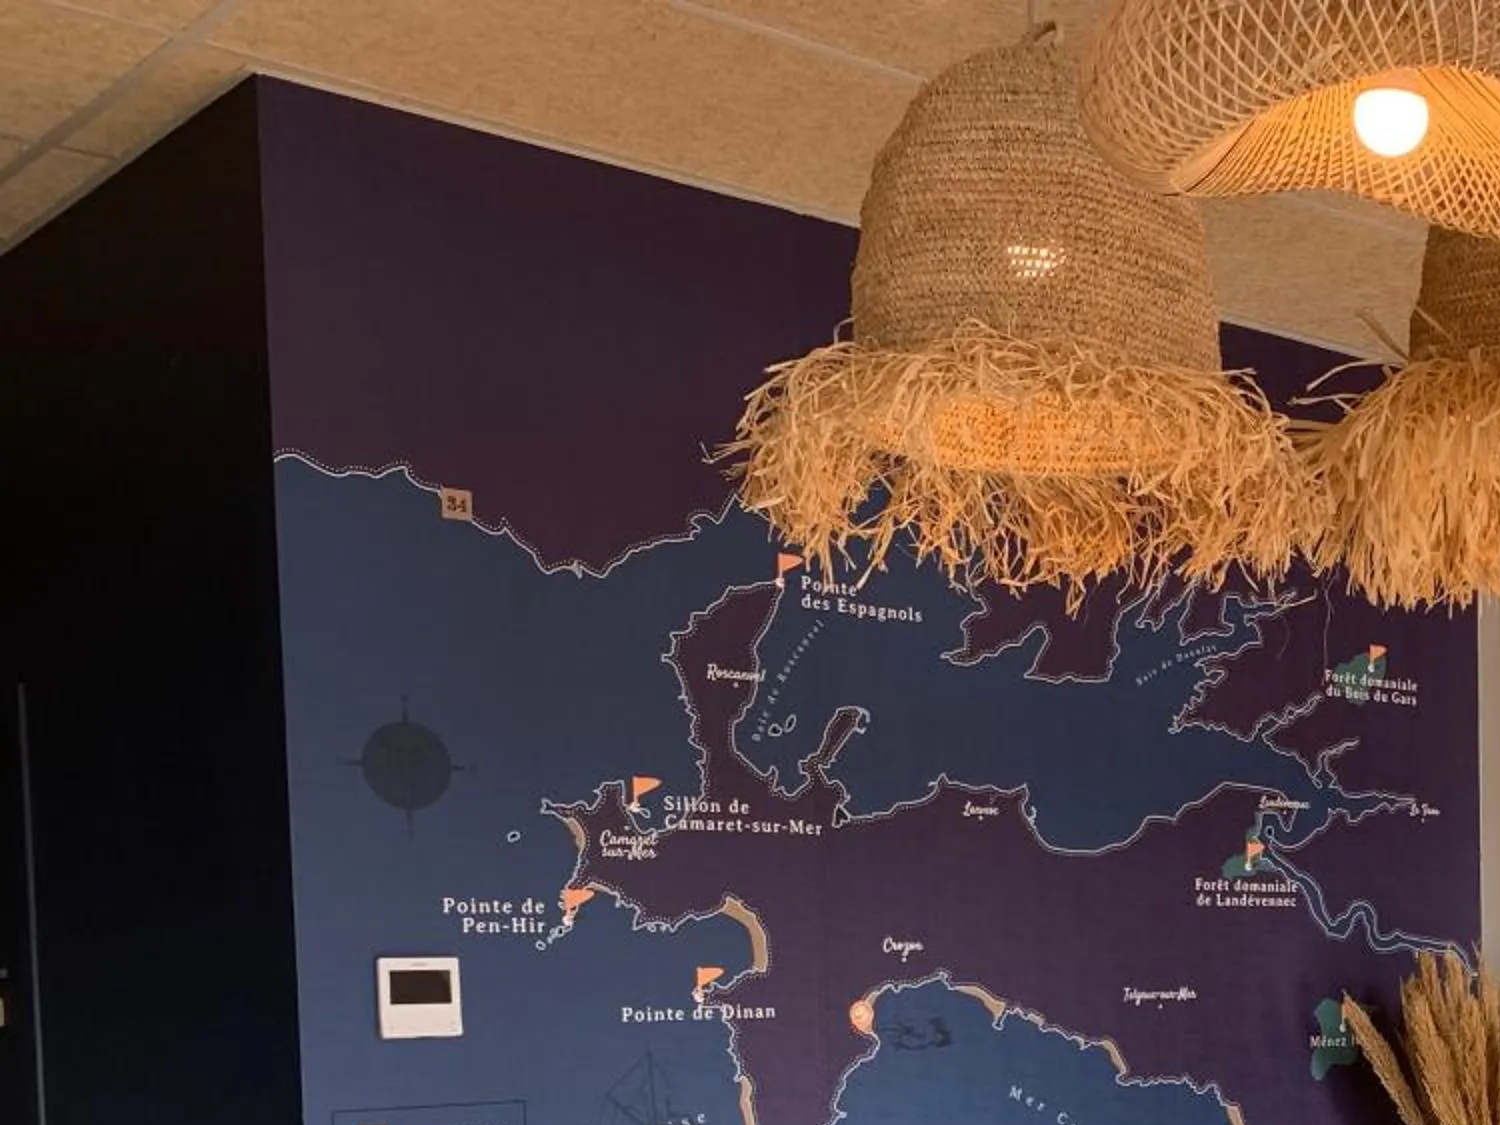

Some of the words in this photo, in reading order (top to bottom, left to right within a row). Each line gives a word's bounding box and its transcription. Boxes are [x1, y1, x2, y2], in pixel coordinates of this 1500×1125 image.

[447, 495, 466, 512] 34
[801, 594, 830, 611] des
[837, 598, 924, 623] Espagnols
[663, 795, 721, 813] Sillon
[729, 798, 750, 815] de
[664, 814, 823, 836] Camaret-sur-Mer
[1194, 877, 1230, 892] Forêt
[1233, 880, 1298, 893] domaniale
[442, 897, 513, 914] Pointe
[521, 897, 545, 914] de
[1195, 894, 1213, 908] de
[462, 917, 545, 934] Pen-Hir
[621, 1006, 685, 1023] Pointe
[692, 1004, 713, 1021] de
[721, 1003, 775, 1020] Dinan
[1009, 1085, 1045, 1112] Mer
